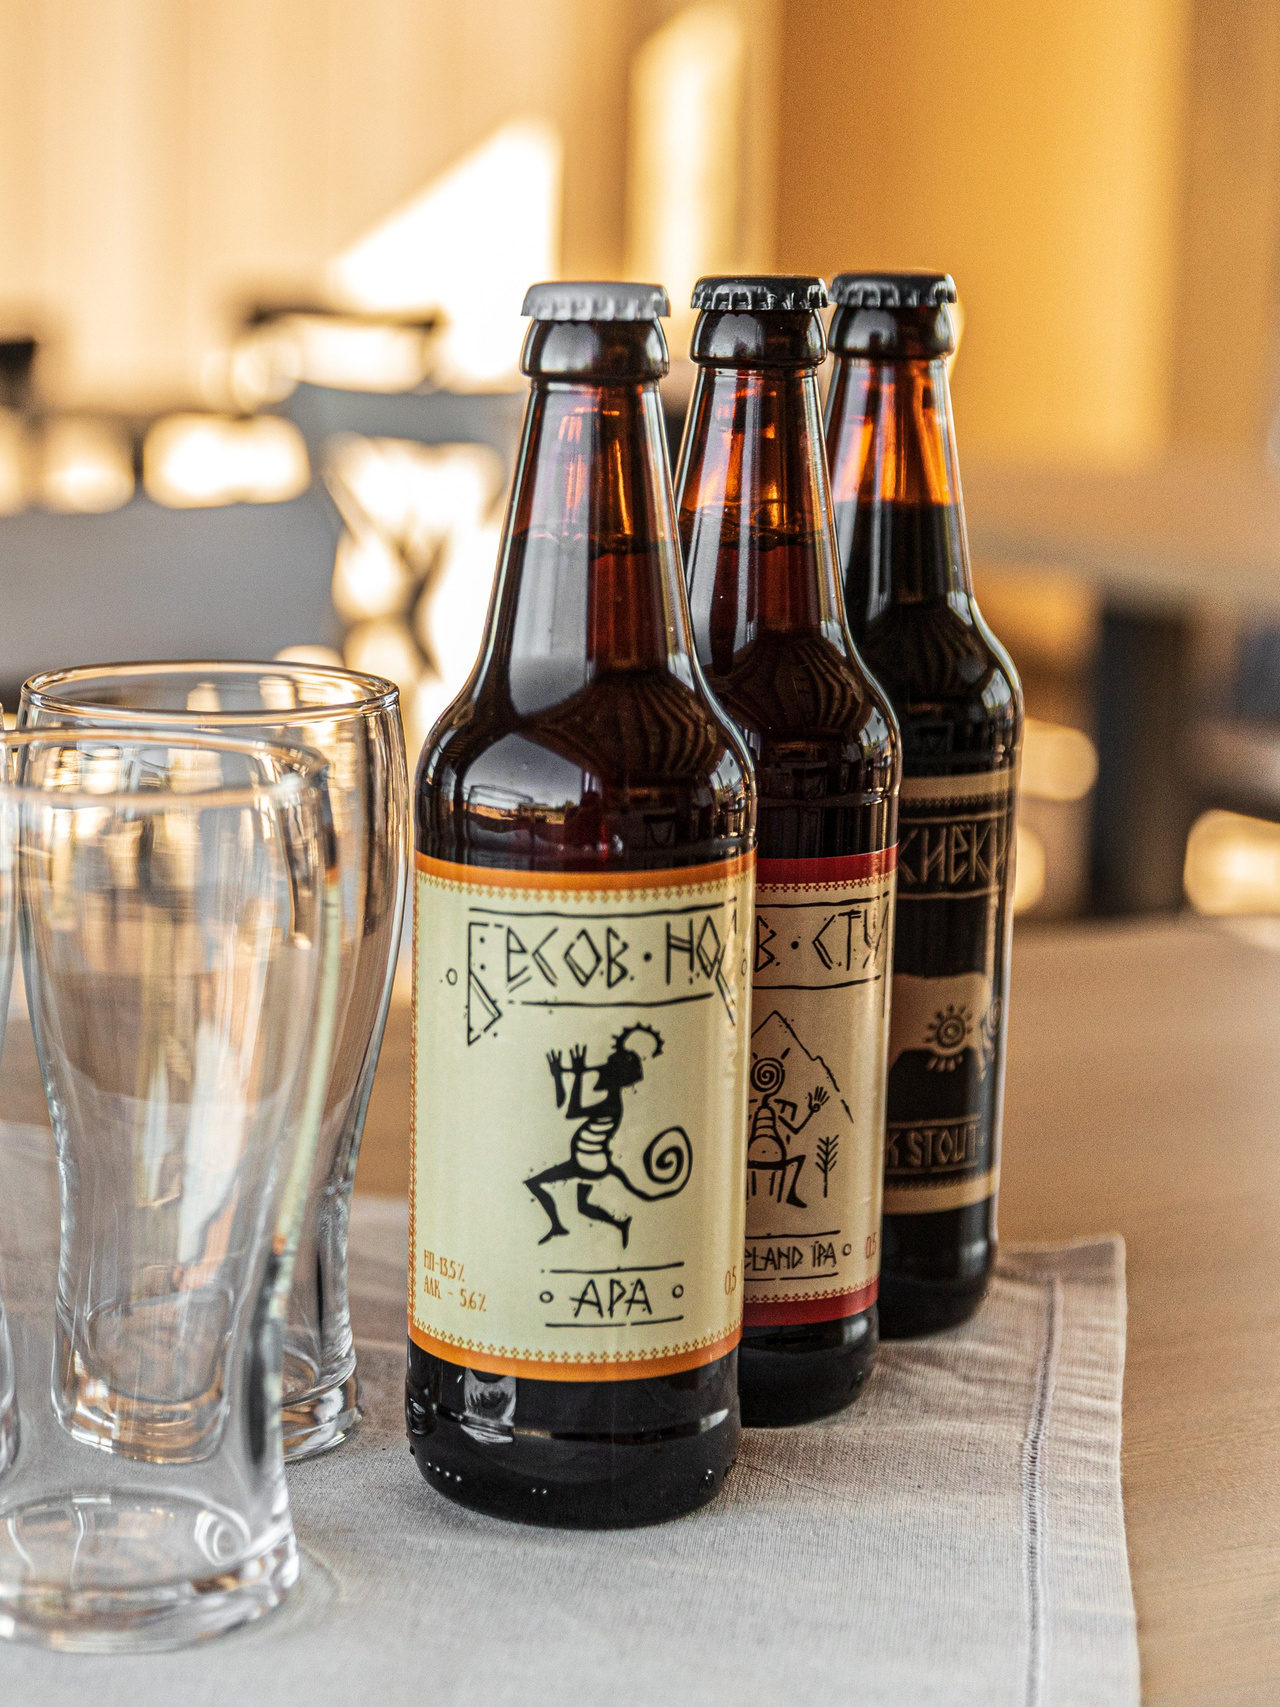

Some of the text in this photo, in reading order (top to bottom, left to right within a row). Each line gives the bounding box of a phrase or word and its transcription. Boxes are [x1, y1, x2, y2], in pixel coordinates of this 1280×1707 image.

[466, 920, 630, 1046] БЕСОВ
[906, 1124, 978, 1167] STOUT
[811, 1241, 837, 1268] IPA
